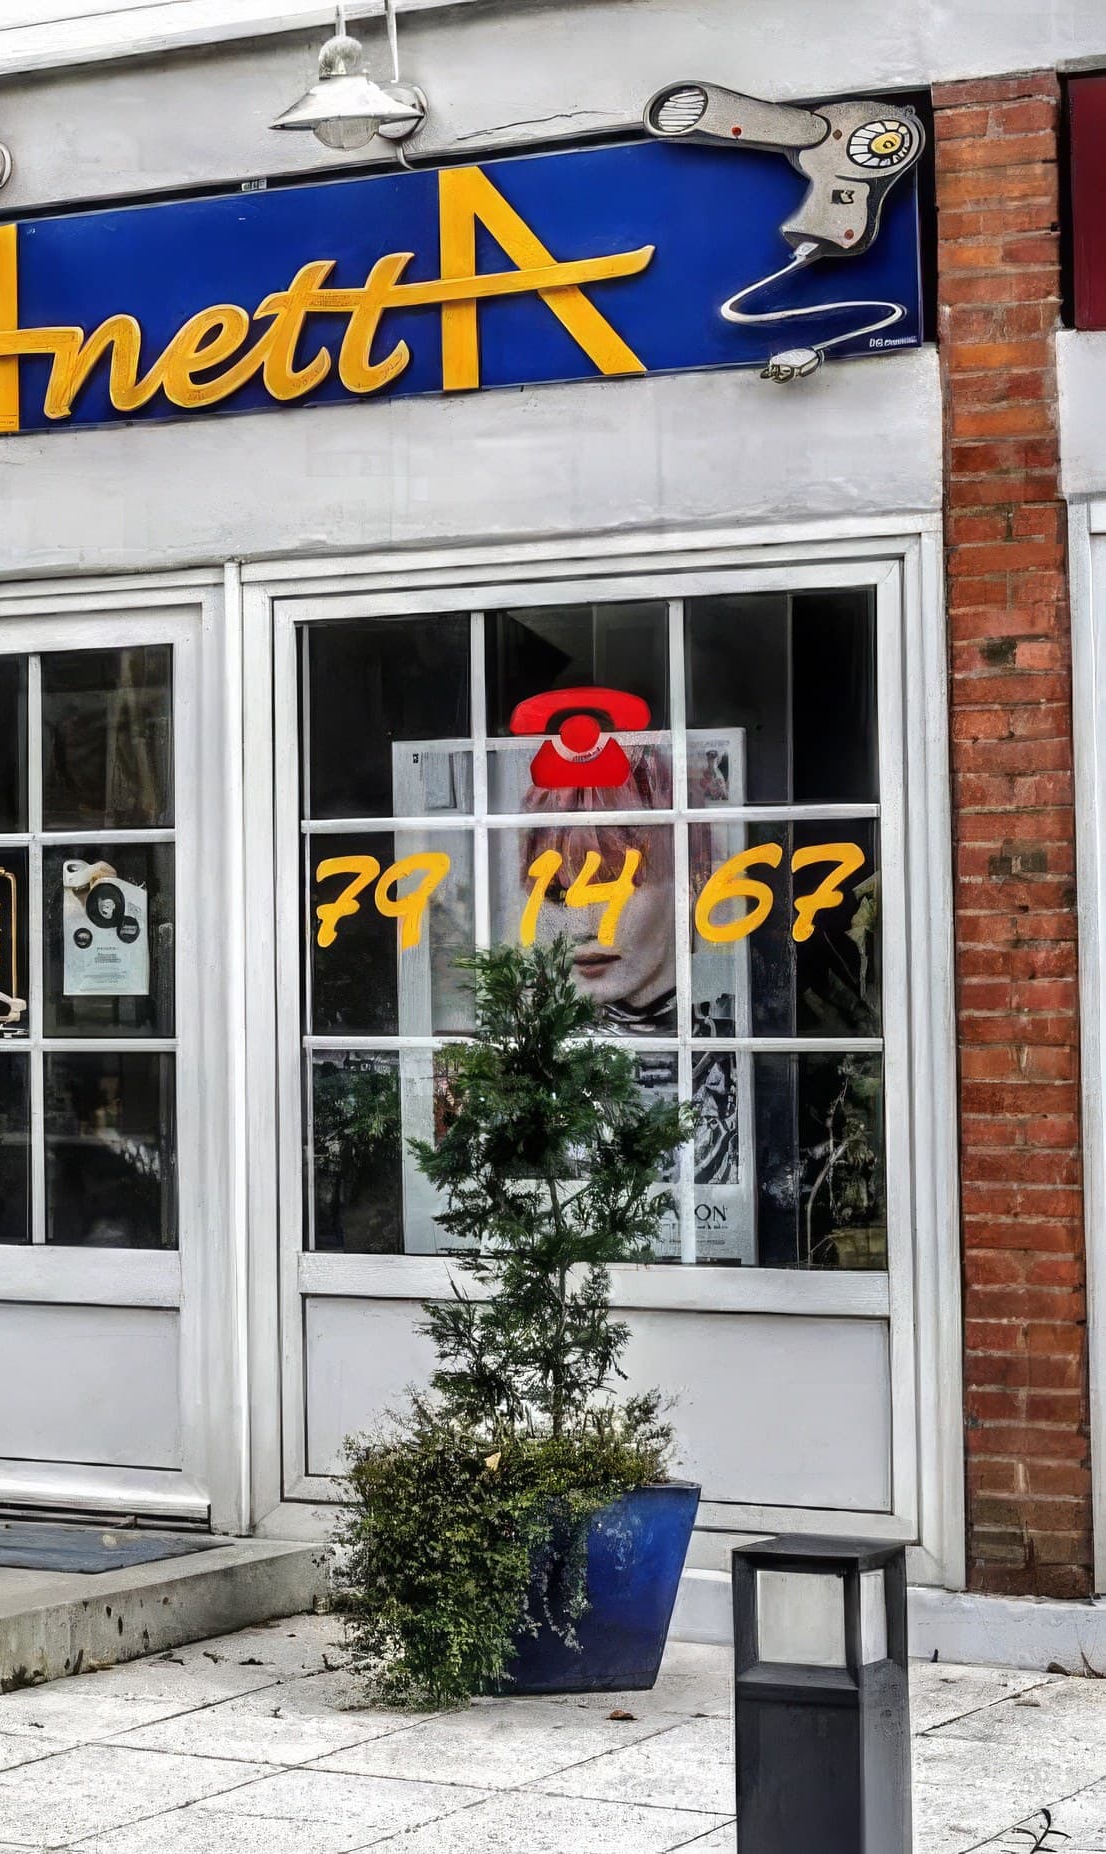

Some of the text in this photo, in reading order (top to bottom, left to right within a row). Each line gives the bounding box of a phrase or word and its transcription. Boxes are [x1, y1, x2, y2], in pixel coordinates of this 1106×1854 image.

[315, 841, 866, 952] 79 14 67
